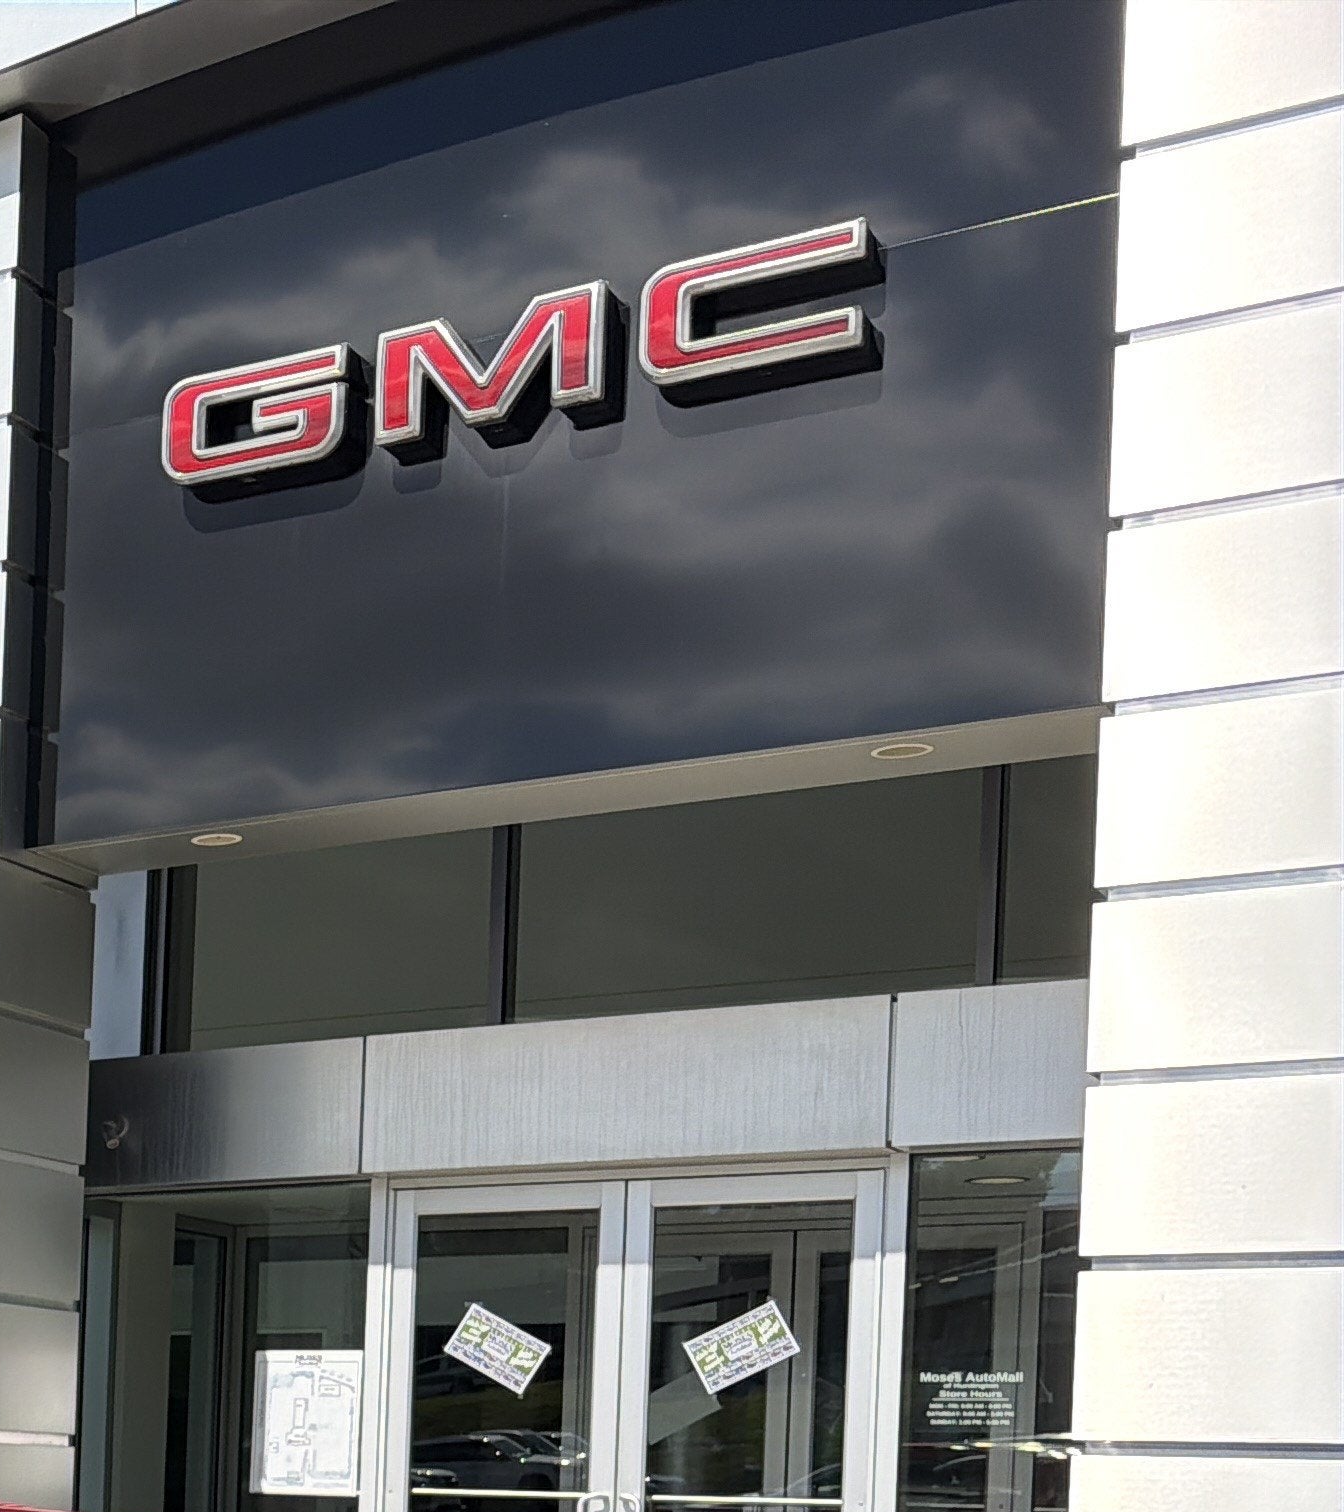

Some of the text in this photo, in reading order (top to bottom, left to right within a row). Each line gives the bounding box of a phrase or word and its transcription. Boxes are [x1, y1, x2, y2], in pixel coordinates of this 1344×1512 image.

[161, 216, 876, 492] GMC
[965, 1371, 1024, 1383] AutoMall
[938, 1390, 1003, 1398] Store Hours
